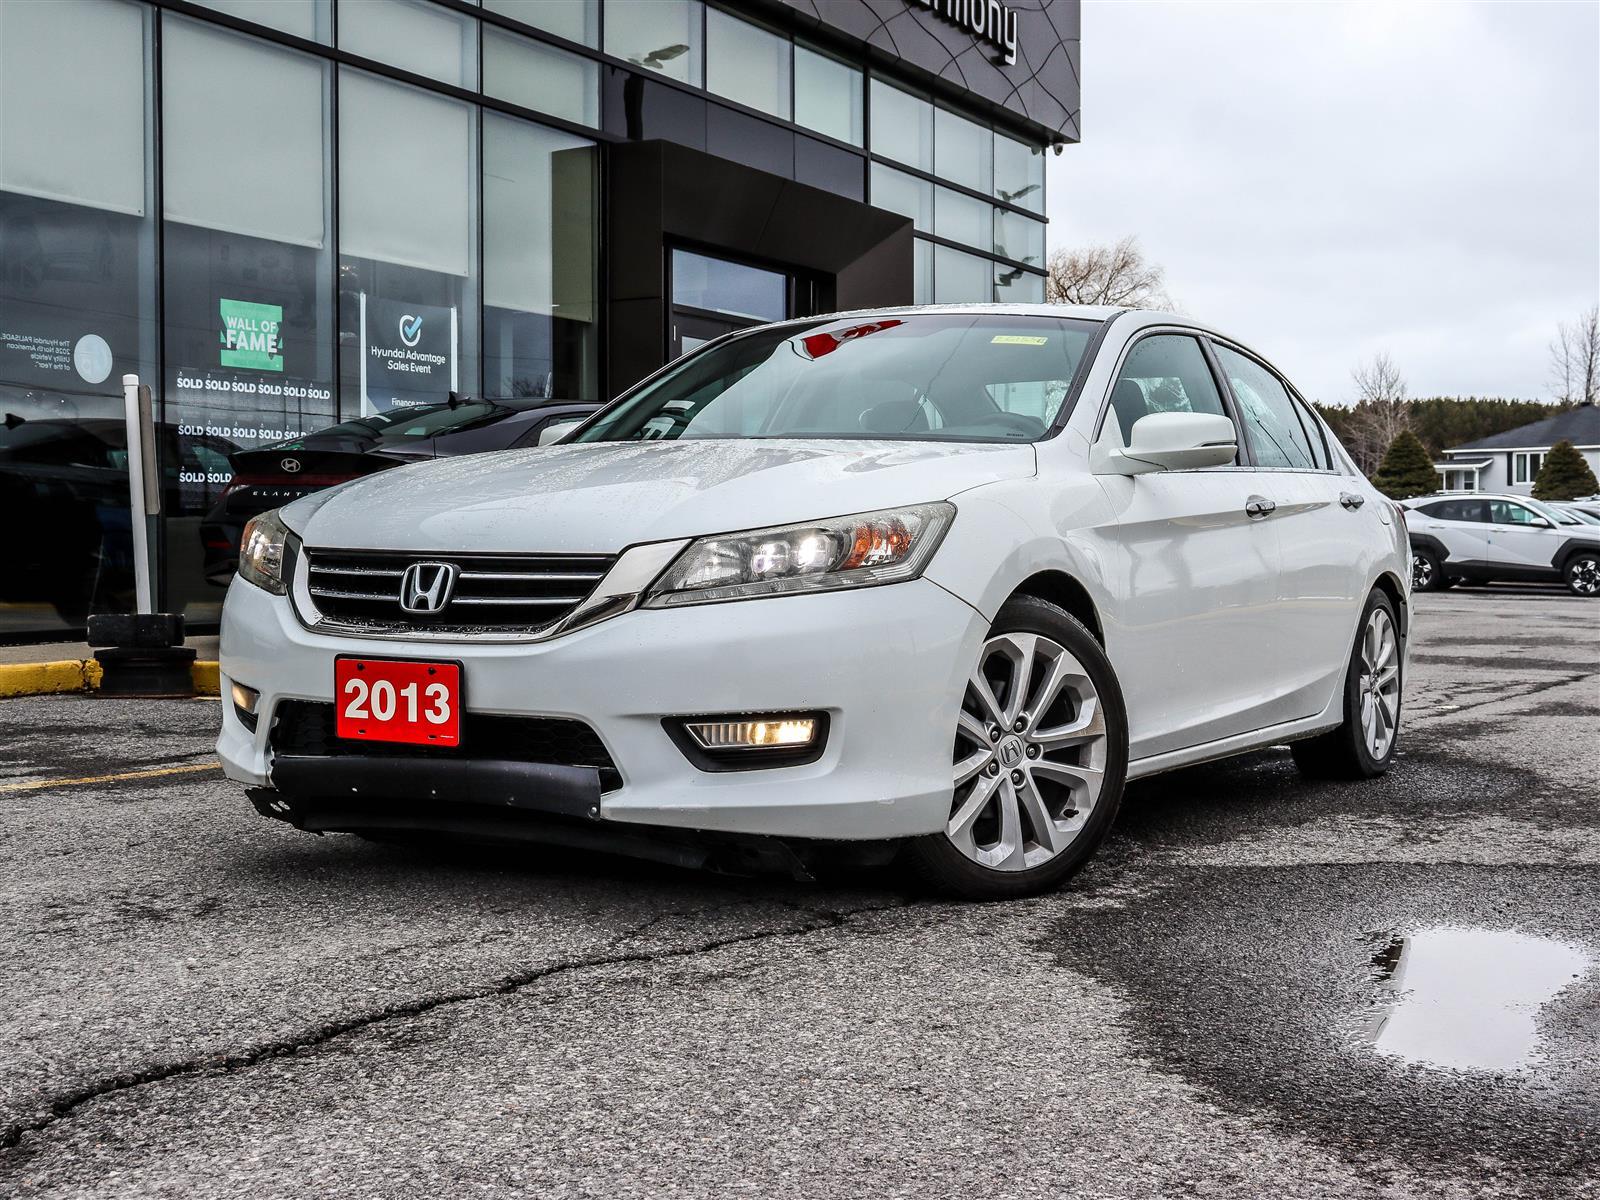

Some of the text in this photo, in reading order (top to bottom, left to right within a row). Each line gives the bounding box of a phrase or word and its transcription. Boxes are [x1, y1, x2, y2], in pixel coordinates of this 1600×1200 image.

[227, 315, 278, 333] WALL OF
[226, 329, 278, 353] FAME
[371, 345, 446, 366] Hyundai Advantage
[387, 360, 432, 374] Sales Event
[177, 377, 331, 400] SOLD SOLD SOLD SOLD SOLD SOLD
[178, 425, 204, 436] SOLD
[206, 426, 231, 437] SOLD
[232, 428, 257, 439] SOLD
[258, 429, 283, 440] SOLD
[179, 472, 232, 483] SOLD SOLD
[344, 678, 451, 725] 2013
